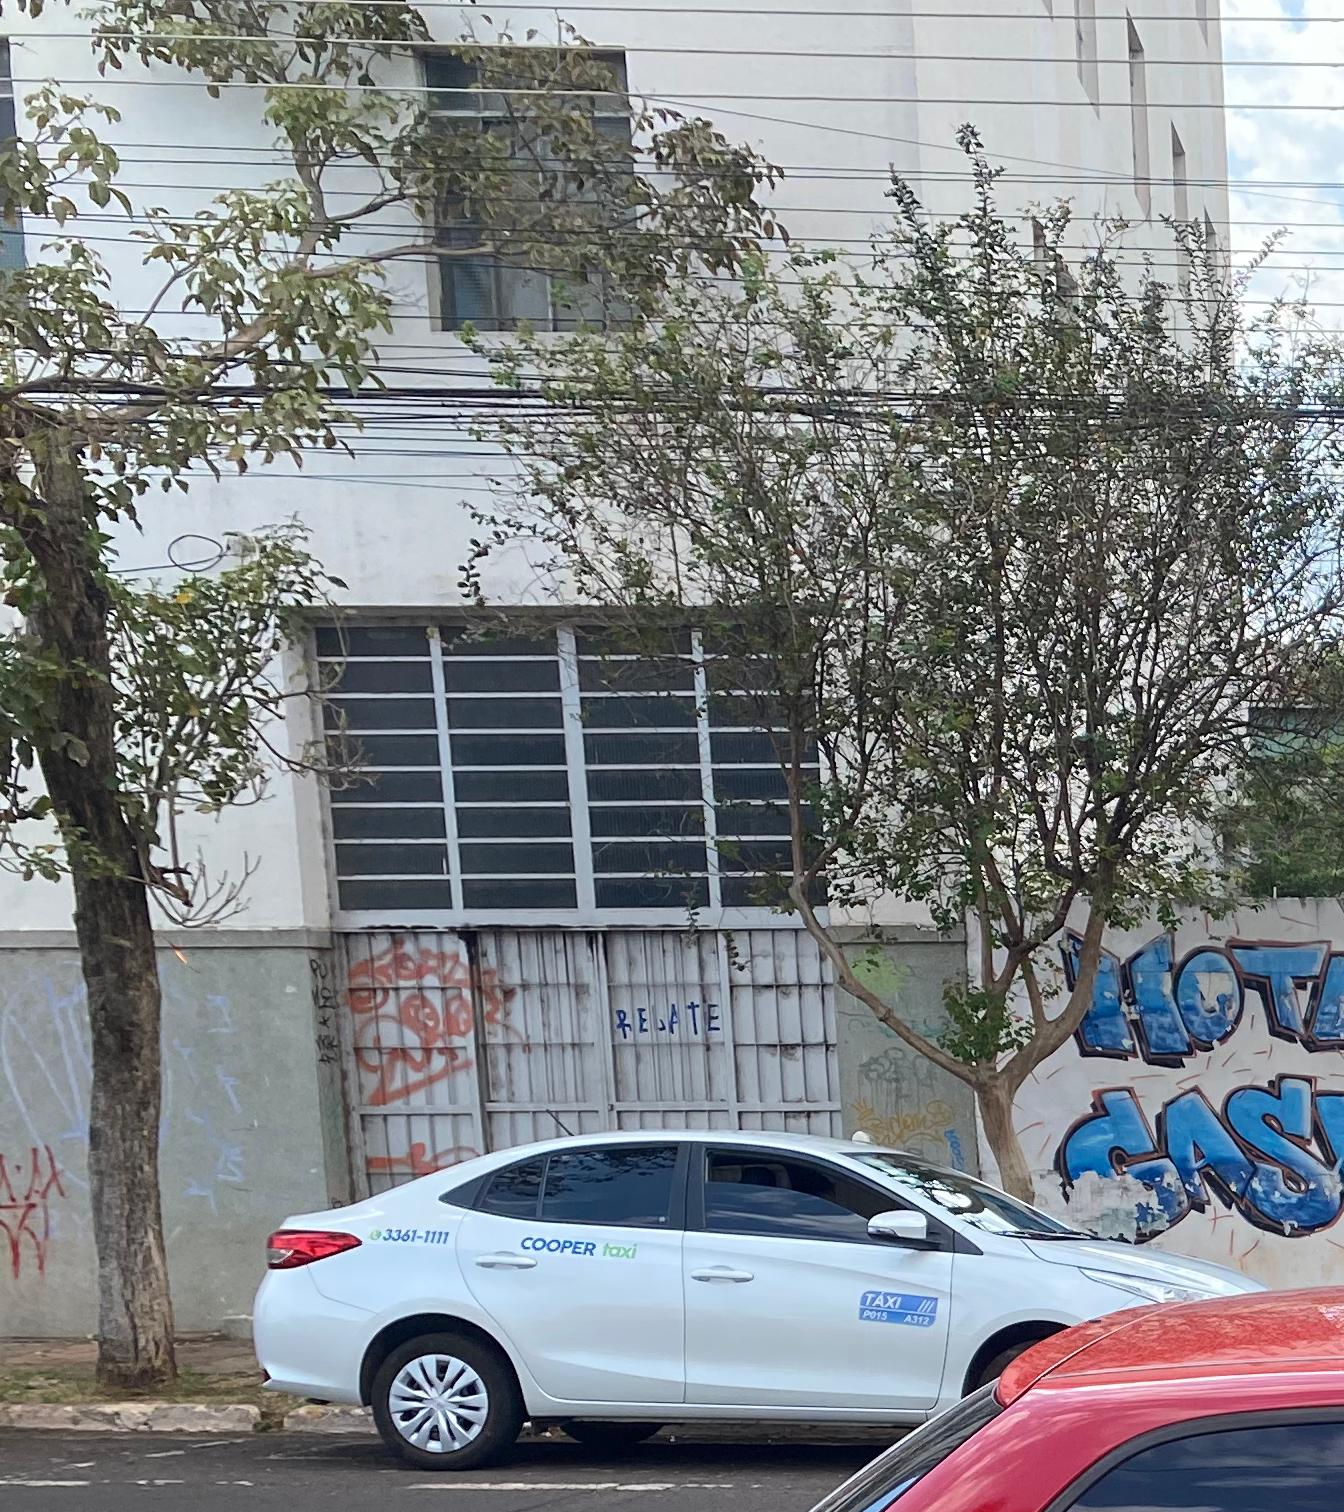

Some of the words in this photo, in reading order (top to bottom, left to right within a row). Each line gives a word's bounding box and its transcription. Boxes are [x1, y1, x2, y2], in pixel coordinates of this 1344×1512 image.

[382, 1228, 450, 1244] 3361-1111
[520, 1236, 597, 1256] COOPER
[602, 1241, 638, 1260] taxi
[862, 1309, 888, 1321] P015
[903, 1314, 930, 1326] A312
